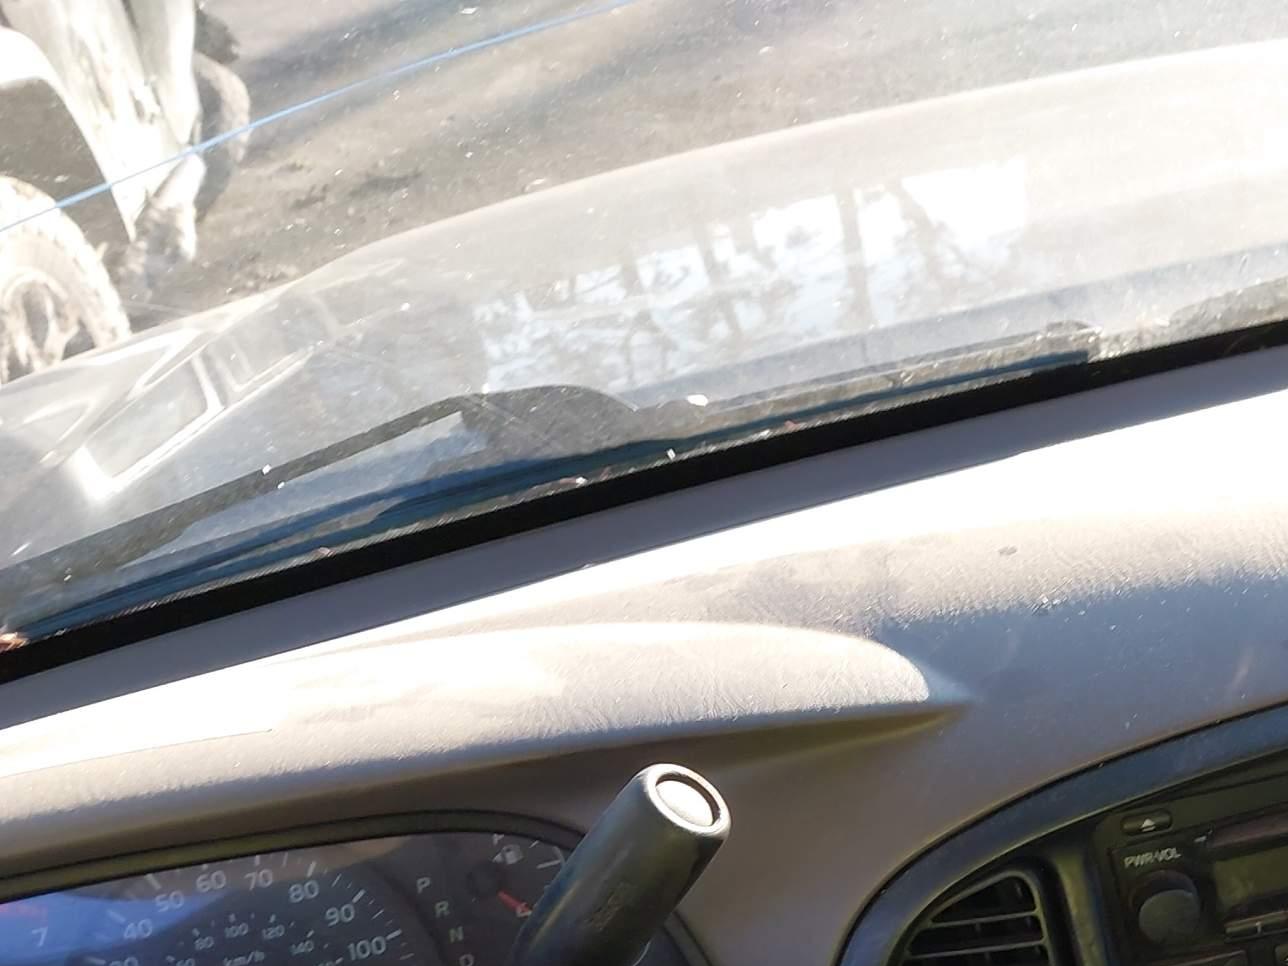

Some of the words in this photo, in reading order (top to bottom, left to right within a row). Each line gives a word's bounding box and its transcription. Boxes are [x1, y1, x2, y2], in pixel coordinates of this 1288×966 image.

[196, 870, 226, 893] 60
[243, 869, 273, 891] 70
[416, 877, 431, 894] P
[155, 890, 185, 912] 50
[288, 880, 320, 903] 80
[324, 903, 355, 927] 90
[435, 900, 450, 918] R
[31, 927, 48, 947] 7
[123, 918, 153, 940] 40
[224, 922, 249, 939] 100
[449, 926, 464, 943] N
[347, 935, 387, 961] 100
